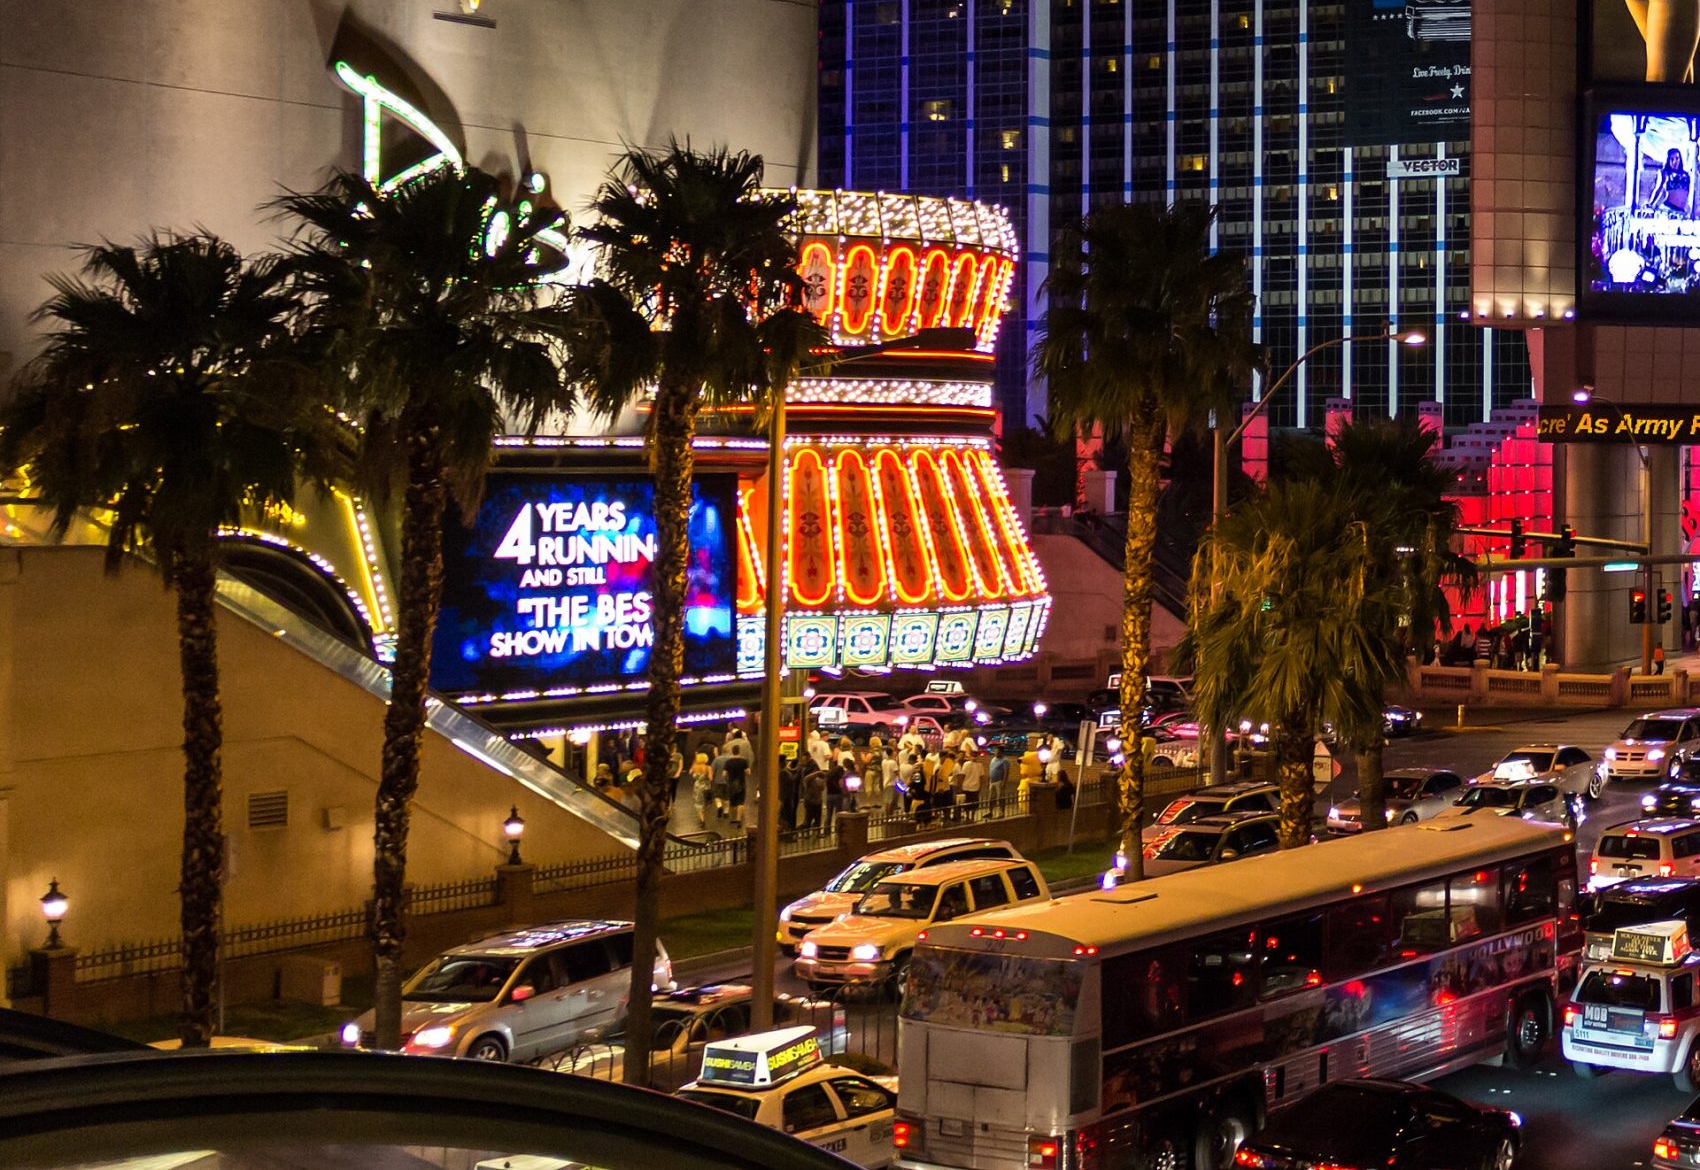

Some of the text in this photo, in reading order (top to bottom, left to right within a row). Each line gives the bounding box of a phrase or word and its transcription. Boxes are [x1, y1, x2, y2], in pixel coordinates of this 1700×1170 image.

[1453, 64, 1471, 76] Drin
[1410, 107, 1471, 116] FACEBOOK.COM/JA
[1403, 159, 1458, 173] VECTOR
[1575, 413, 1609, 434] As
[1616, 413, 1684, 440] Army
[493, 501, 627, 565] 4 YEARS
[537, 533, 658, 566] RUNNIN
[519, 567, 606, 588] AND STILL
[597, 592, 653, 624] BES
[489, 623, 653, 657] SHOW IN TOW
[1585, 1005, 1607, 1022] MOB
[1575, 1029, 1589, 1039] 5111
[705, 1056, 756, 1071] SUSHISAMBA
[767, 1037, 818, 1071] SUSHISAMBA
